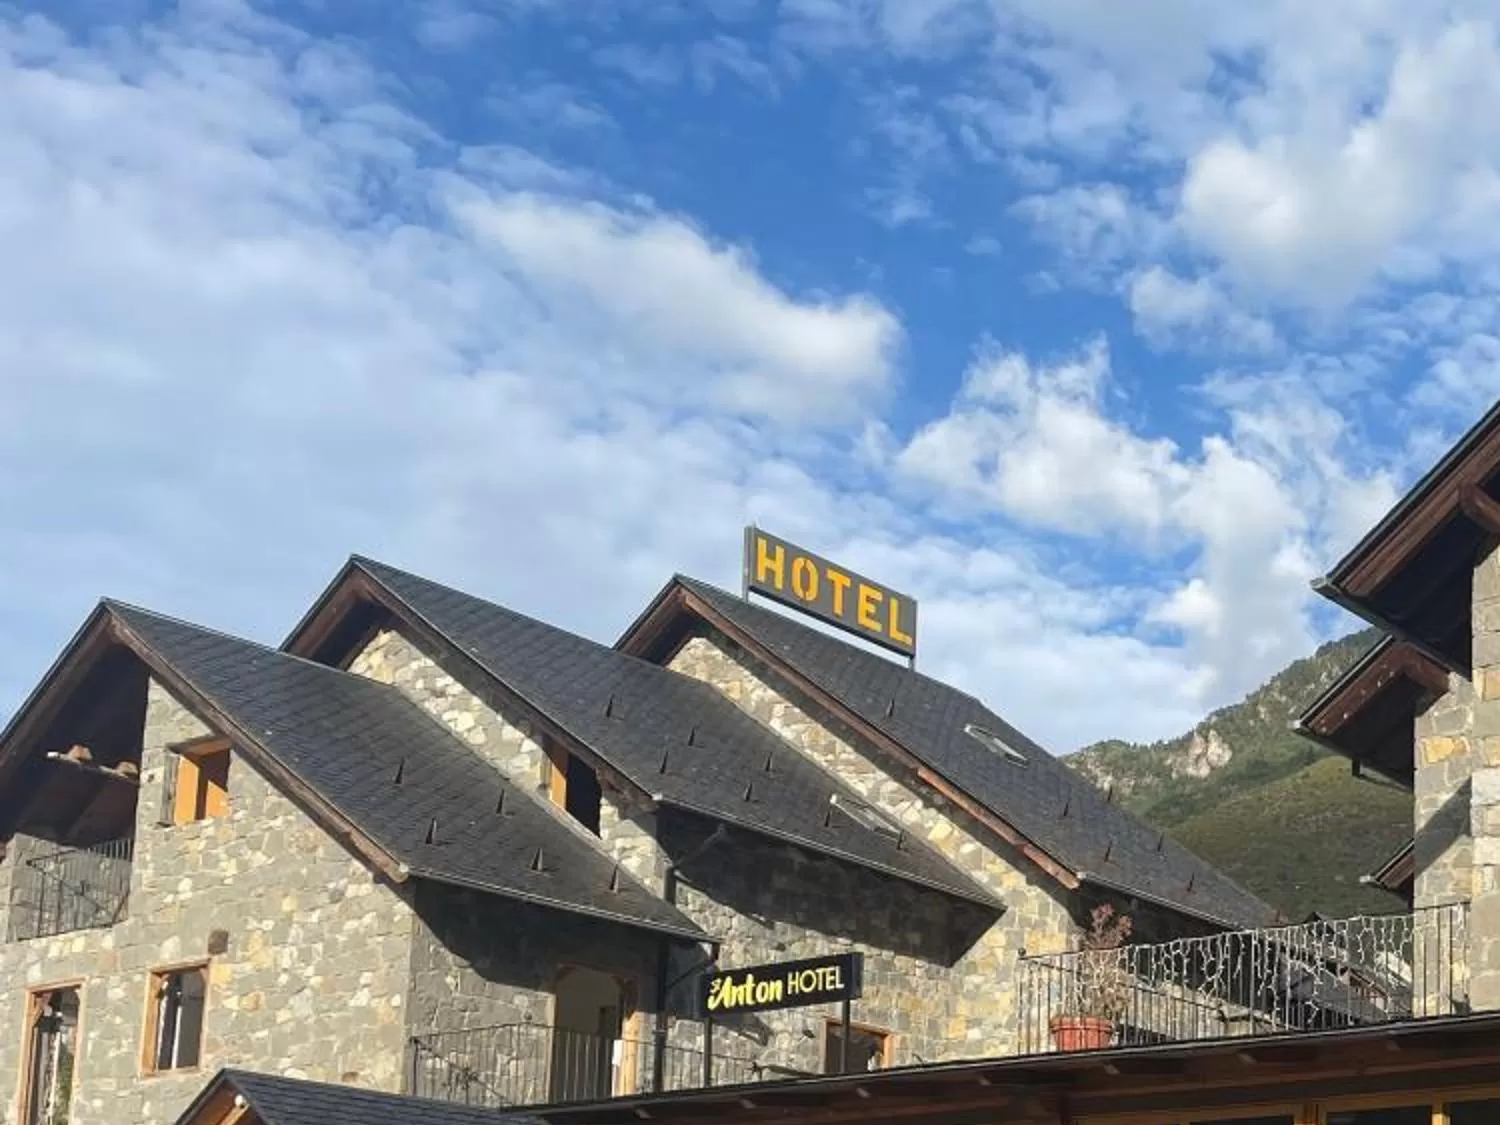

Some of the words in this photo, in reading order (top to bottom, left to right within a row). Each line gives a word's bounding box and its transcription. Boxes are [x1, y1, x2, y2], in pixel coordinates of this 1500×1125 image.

[756, 536, 913, 646] HOTEL
[707, 973, 783, 1010] Anton
[787, 965, 845, 995] HOTEL
